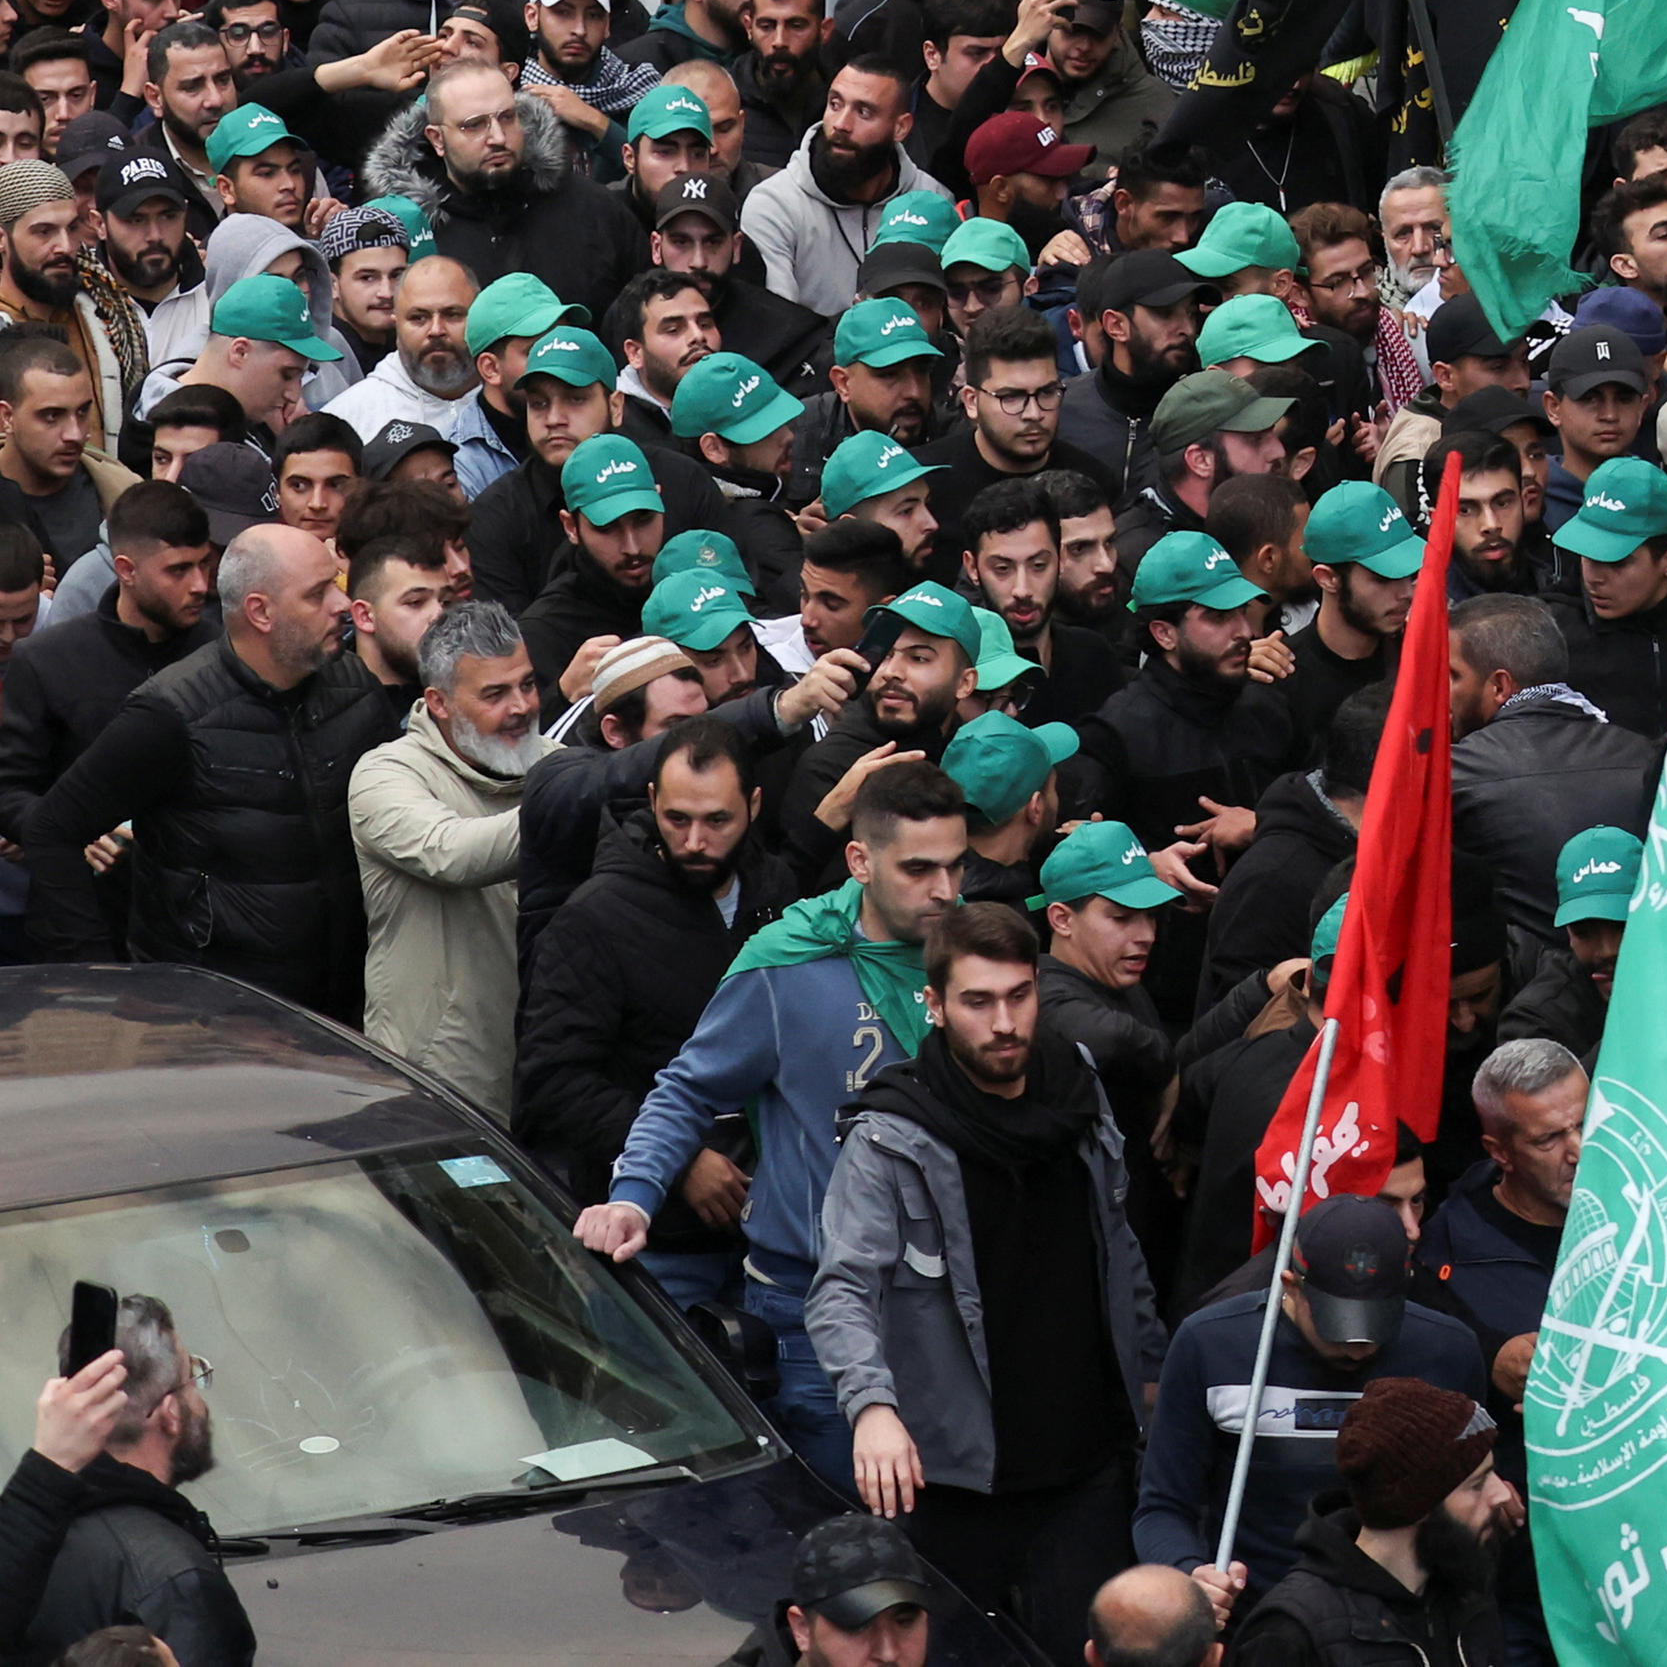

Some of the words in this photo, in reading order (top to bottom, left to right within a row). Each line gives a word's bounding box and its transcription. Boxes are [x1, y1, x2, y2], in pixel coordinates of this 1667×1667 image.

[666, 97, 703, 113] حماس
[247, 112, 281, 129] حماس
[119, 157, 169, 186] PARIS
[888, 210, 929, 226] حماس
[881, 314, 916, 336] حماس
[536, 337, 580, 358] حماس
[731, 376, 760, 408] حماس
[596, 460, 638, 484] حماس
[1585, 490, 1627, 512] حماس
[690, 586, 726, 612] حماس
[897, 590, 943, 608] حماس
[1572, 857, 1622, 884] حماس
[853, 1026, 884, 1090] 2
